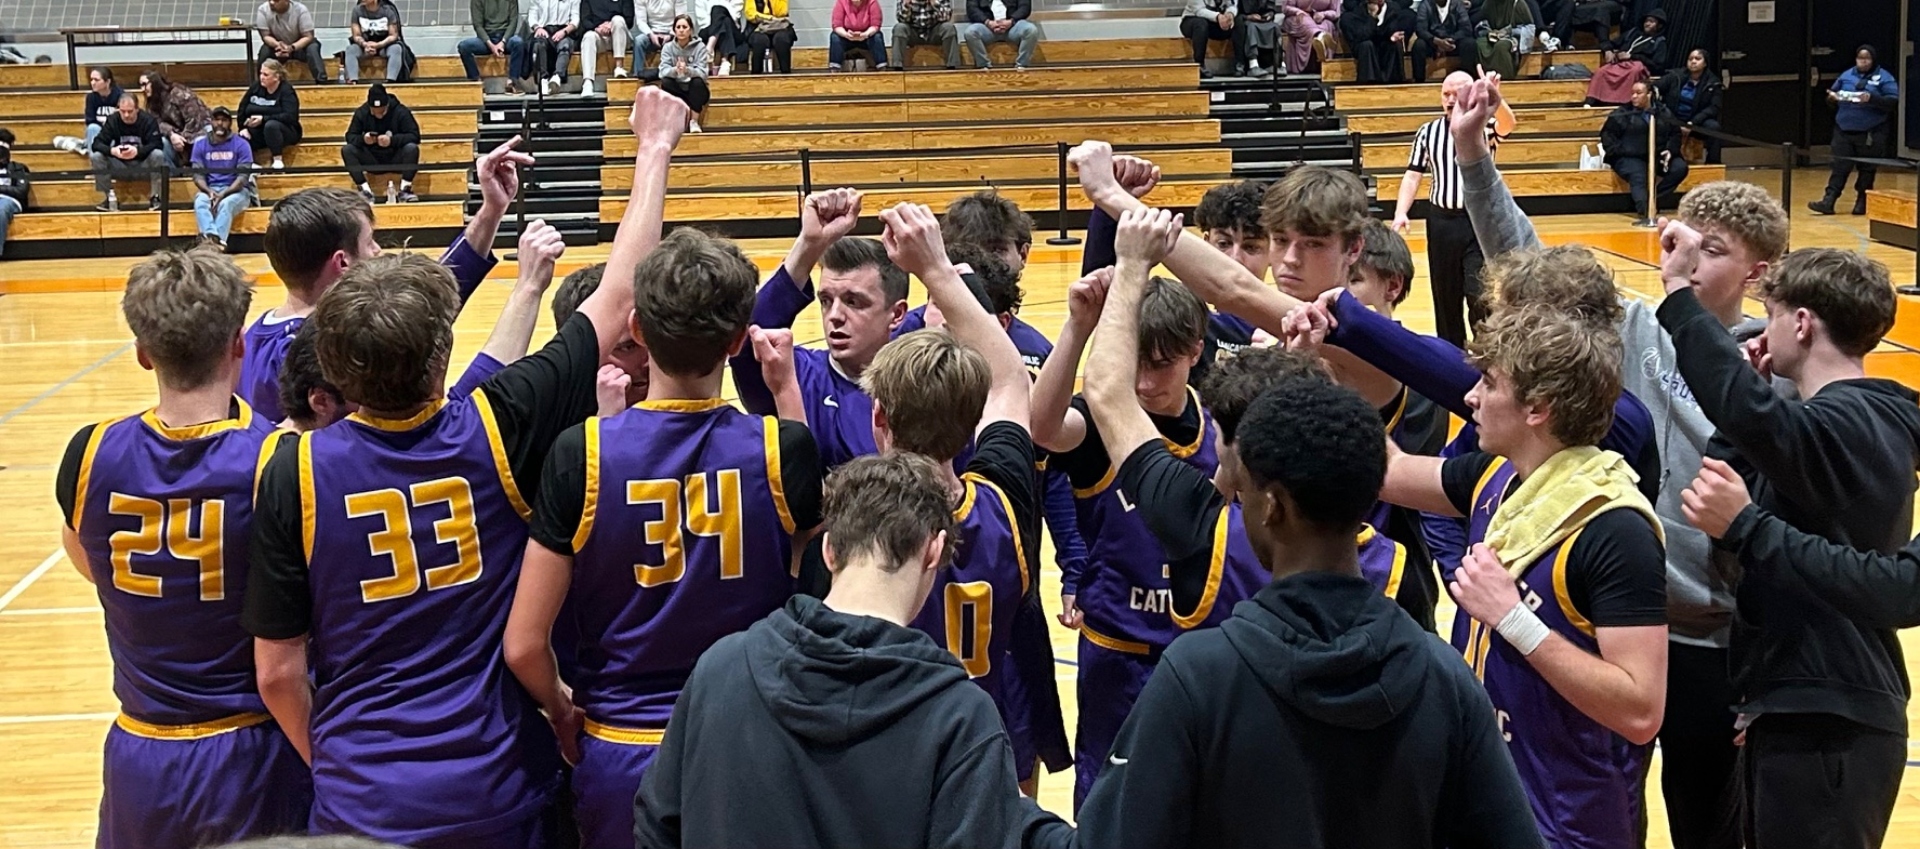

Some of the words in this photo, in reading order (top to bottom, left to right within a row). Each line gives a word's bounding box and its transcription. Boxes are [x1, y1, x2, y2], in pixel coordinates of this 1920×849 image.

[108, 491, 225, 601] 24
[344, 476, 483, 603] 33
[626, 468, 743, 588] 34
[1116, 488, 1136, 512] L
[944, 580, 993, 679] 0
[1129, 586, 1169, 613] CAT
